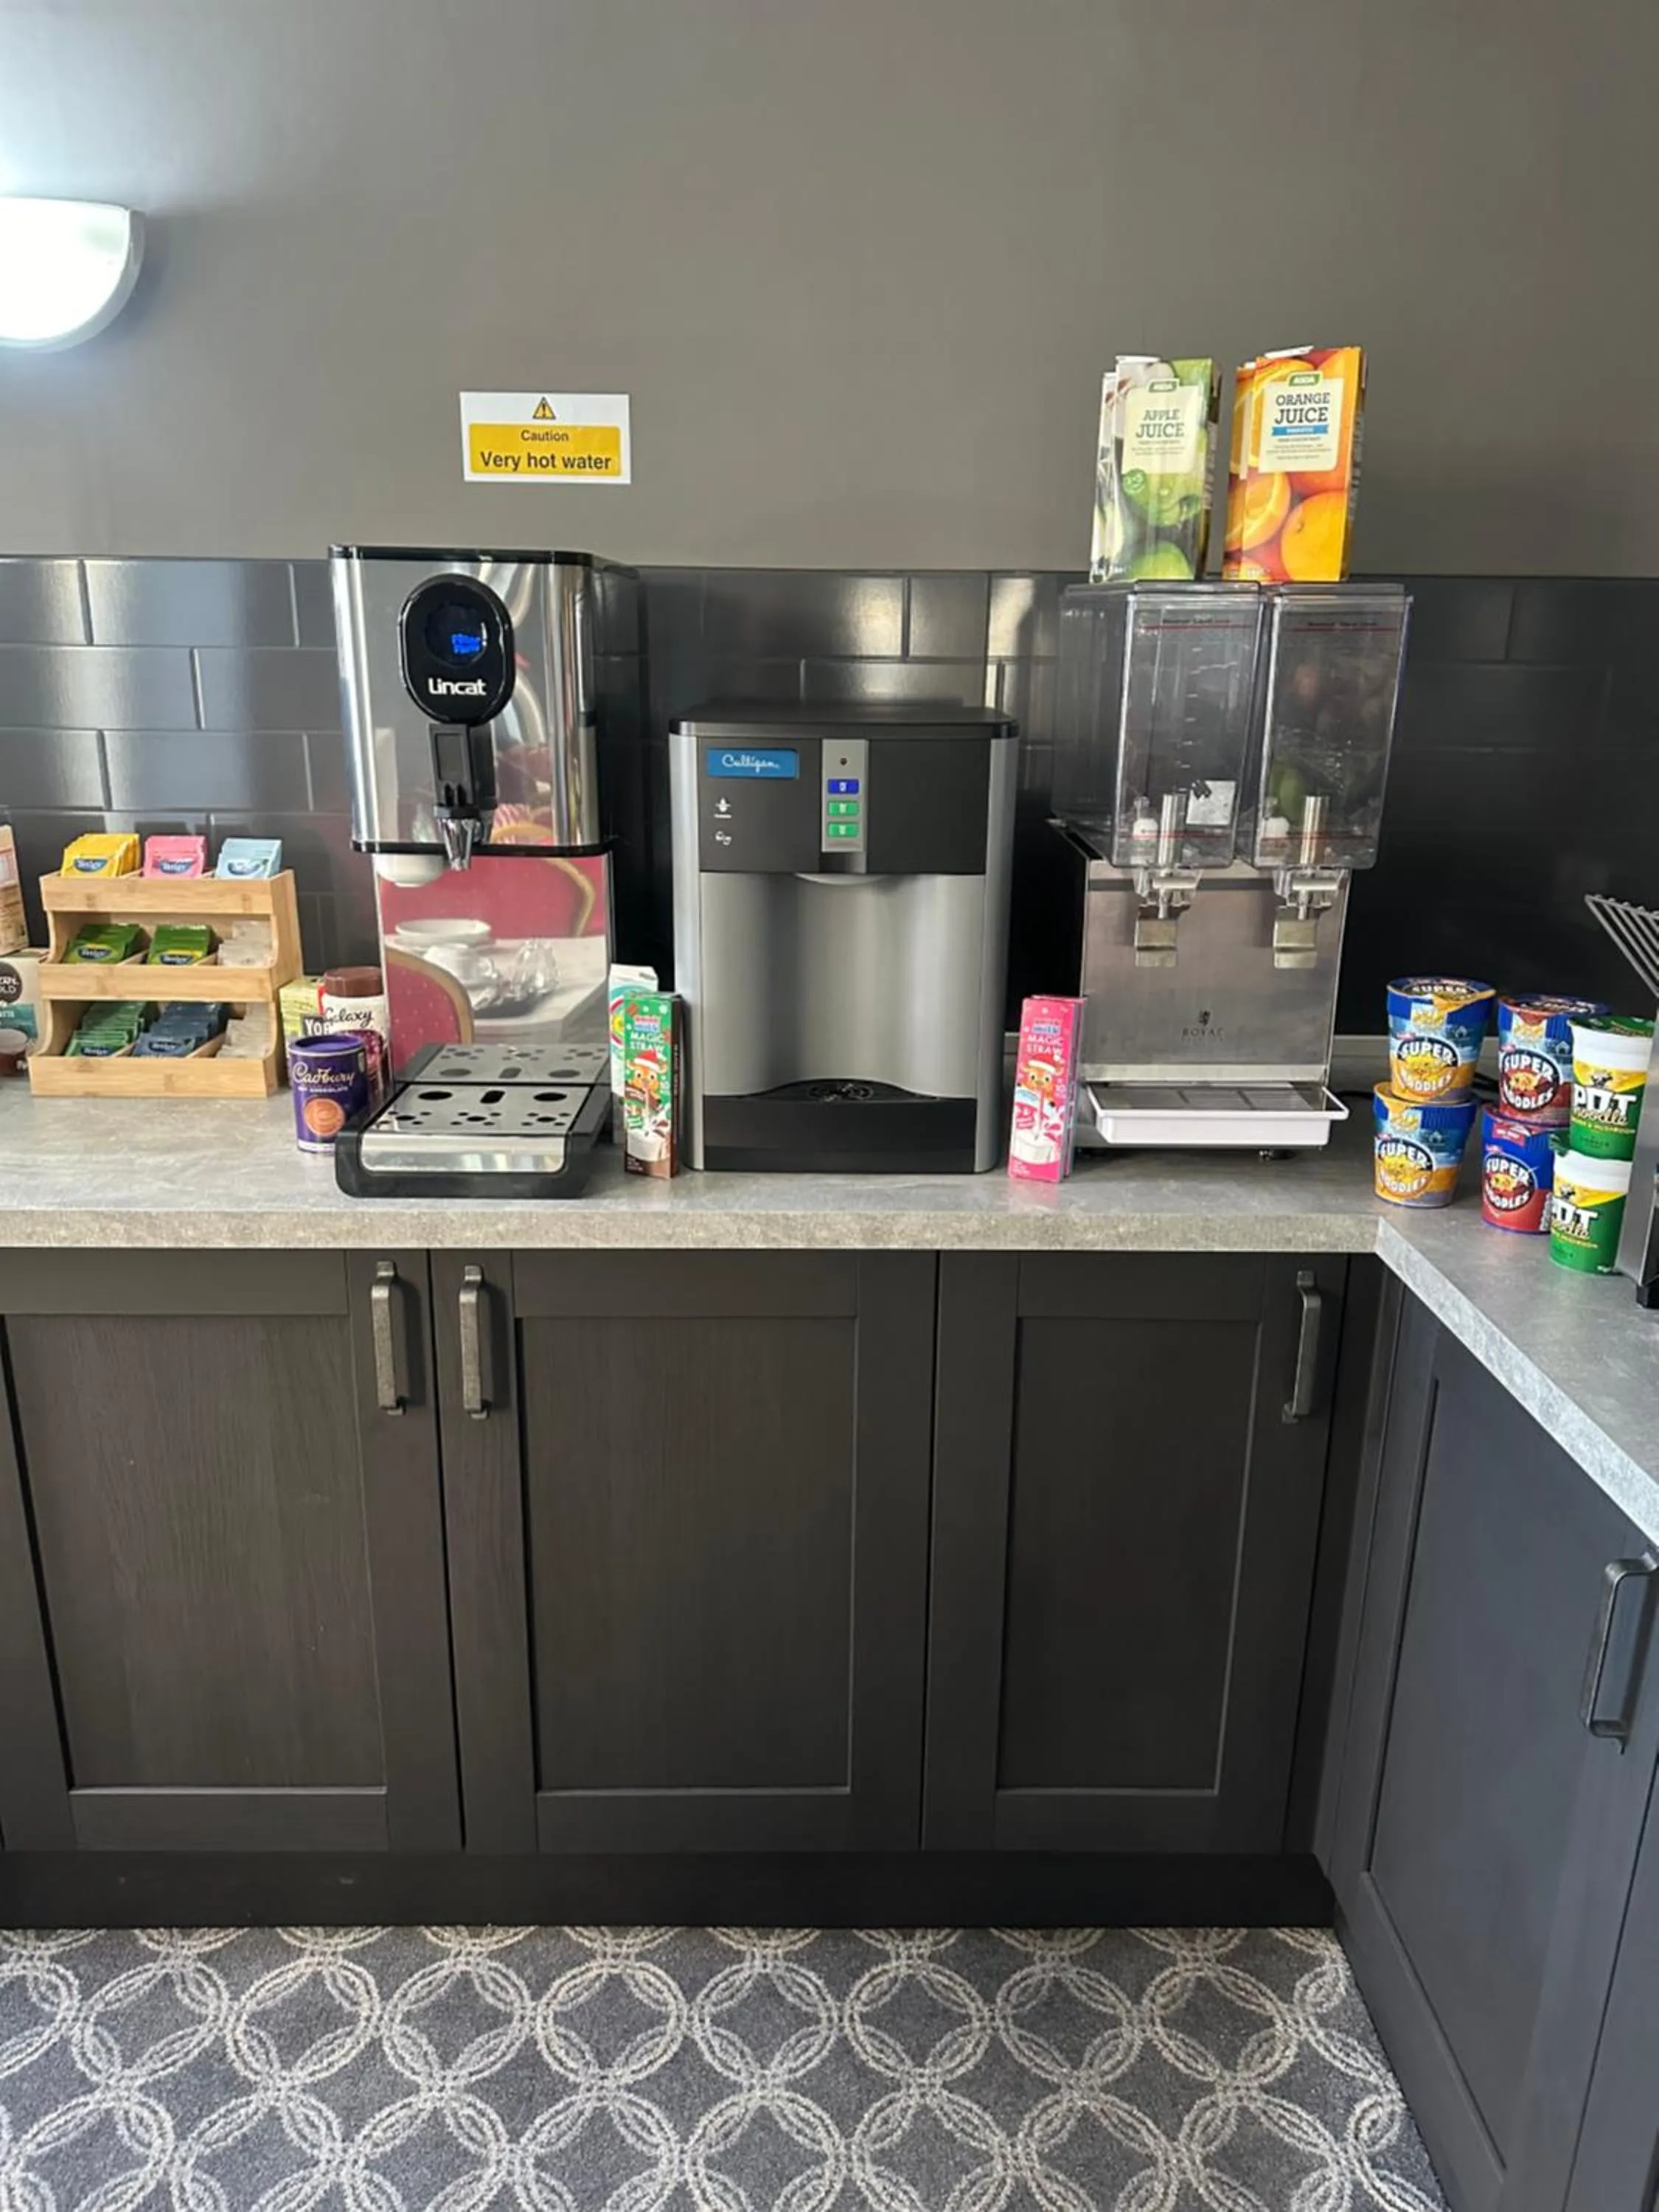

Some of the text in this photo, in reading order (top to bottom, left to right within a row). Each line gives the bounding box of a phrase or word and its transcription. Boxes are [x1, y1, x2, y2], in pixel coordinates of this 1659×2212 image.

[1276, 392, 1330, 406] ORANGE
[1144, 408, 1180, 421] APPLE
[1274, 406, 1329, 425] JUICE
[521, 430, 568, 442] Caution
[1135, 422, 1185, 438] JUICE
[480, 451, 611, 472] Very hot water
[428, 678, 487, 695] Lincat
[722, 754, 780, 773] Culligan
[323, 1006, 373, 1027] Galaxy
[1028, 1034, 1064, 1046] MAGIC
[1401, 1040, 1454, 1065] SUPER
[293, 1062, 355, 1085] Cadbury
[1503, 1052, 1554, 1083] SUPER
[1573, 1084, 1637, 1117] POT
[1379, 1142, 1428, 1168] SUPER
[1486, 1157, 1531, 1187] SUPER
